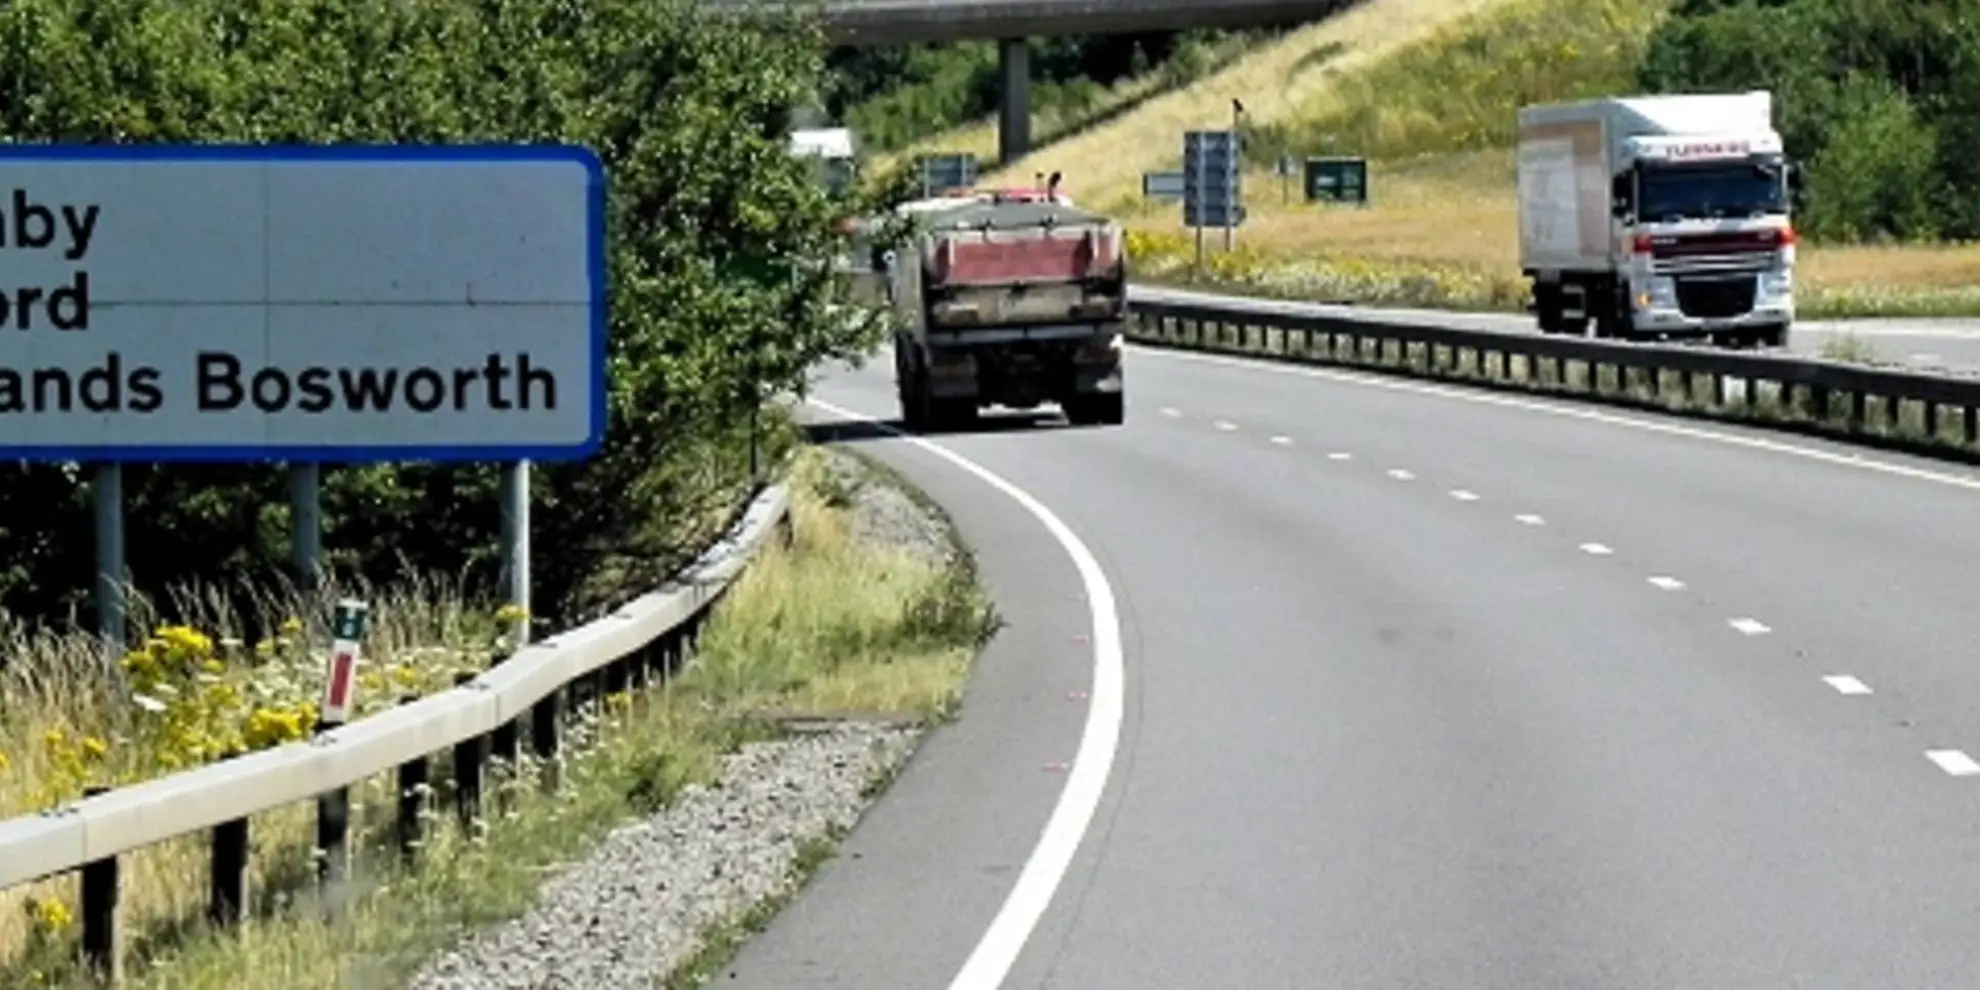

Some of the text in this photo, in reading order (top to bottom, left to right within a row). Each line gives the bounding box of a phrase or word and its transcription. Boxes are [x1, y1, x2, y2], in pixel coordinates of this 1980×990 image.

[0, 189, 99, 261] by
[0, 271, 88, 330] rd
[197, 352, 556, 412] Bosworth
